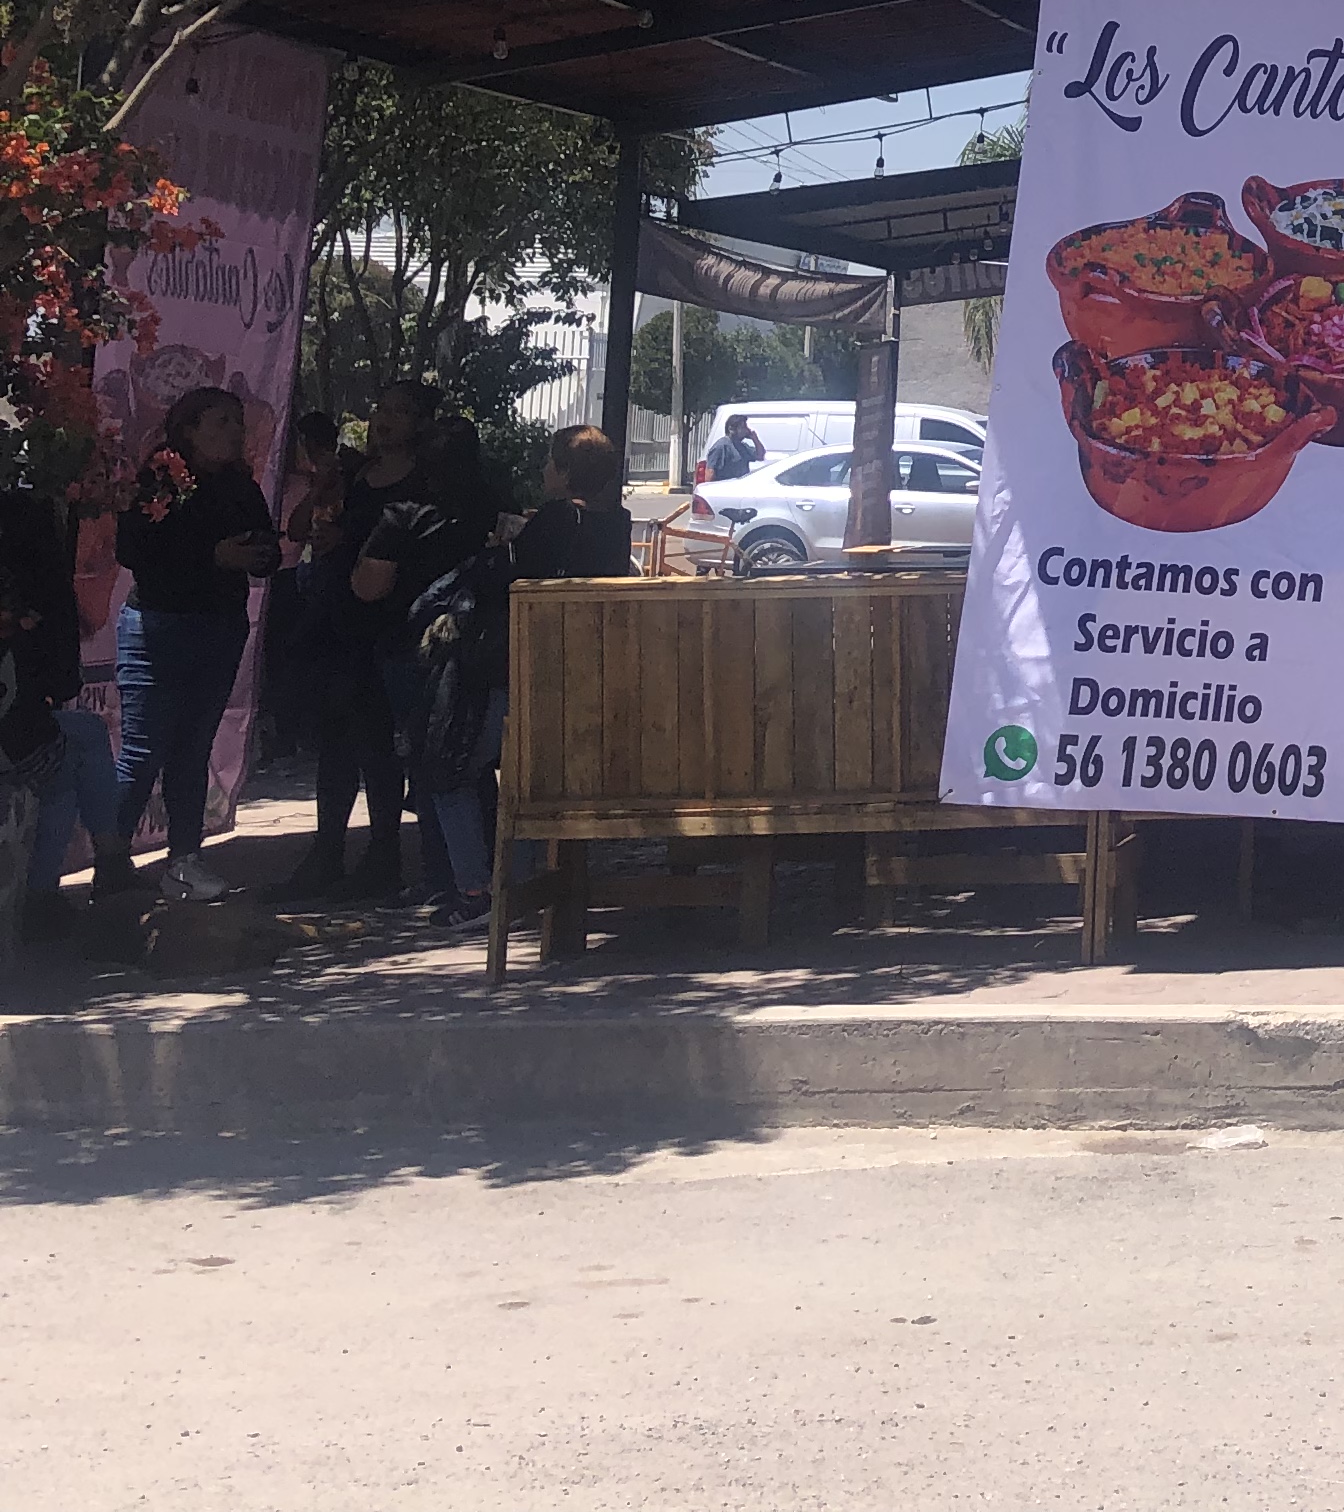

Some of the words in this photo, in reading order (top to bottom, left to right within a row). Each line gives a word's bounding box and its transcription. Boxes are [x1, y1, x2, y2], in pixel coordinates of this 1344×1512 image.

[1045, 20, 1170, 133] “Los
[1037, 546, 1240, 597] Contamos
[1250, 569, 1324, 603] con
[1073, 612, 1235, 660] Servicio
[1244, 632, 1269, 662] a
[1067, 676, 1263, 724] Domicilio
[1053, 733, 1104, 788] 56
[1121, 735, 1218, 792] 1380
[1227, 740, 1327, 798] 0603
